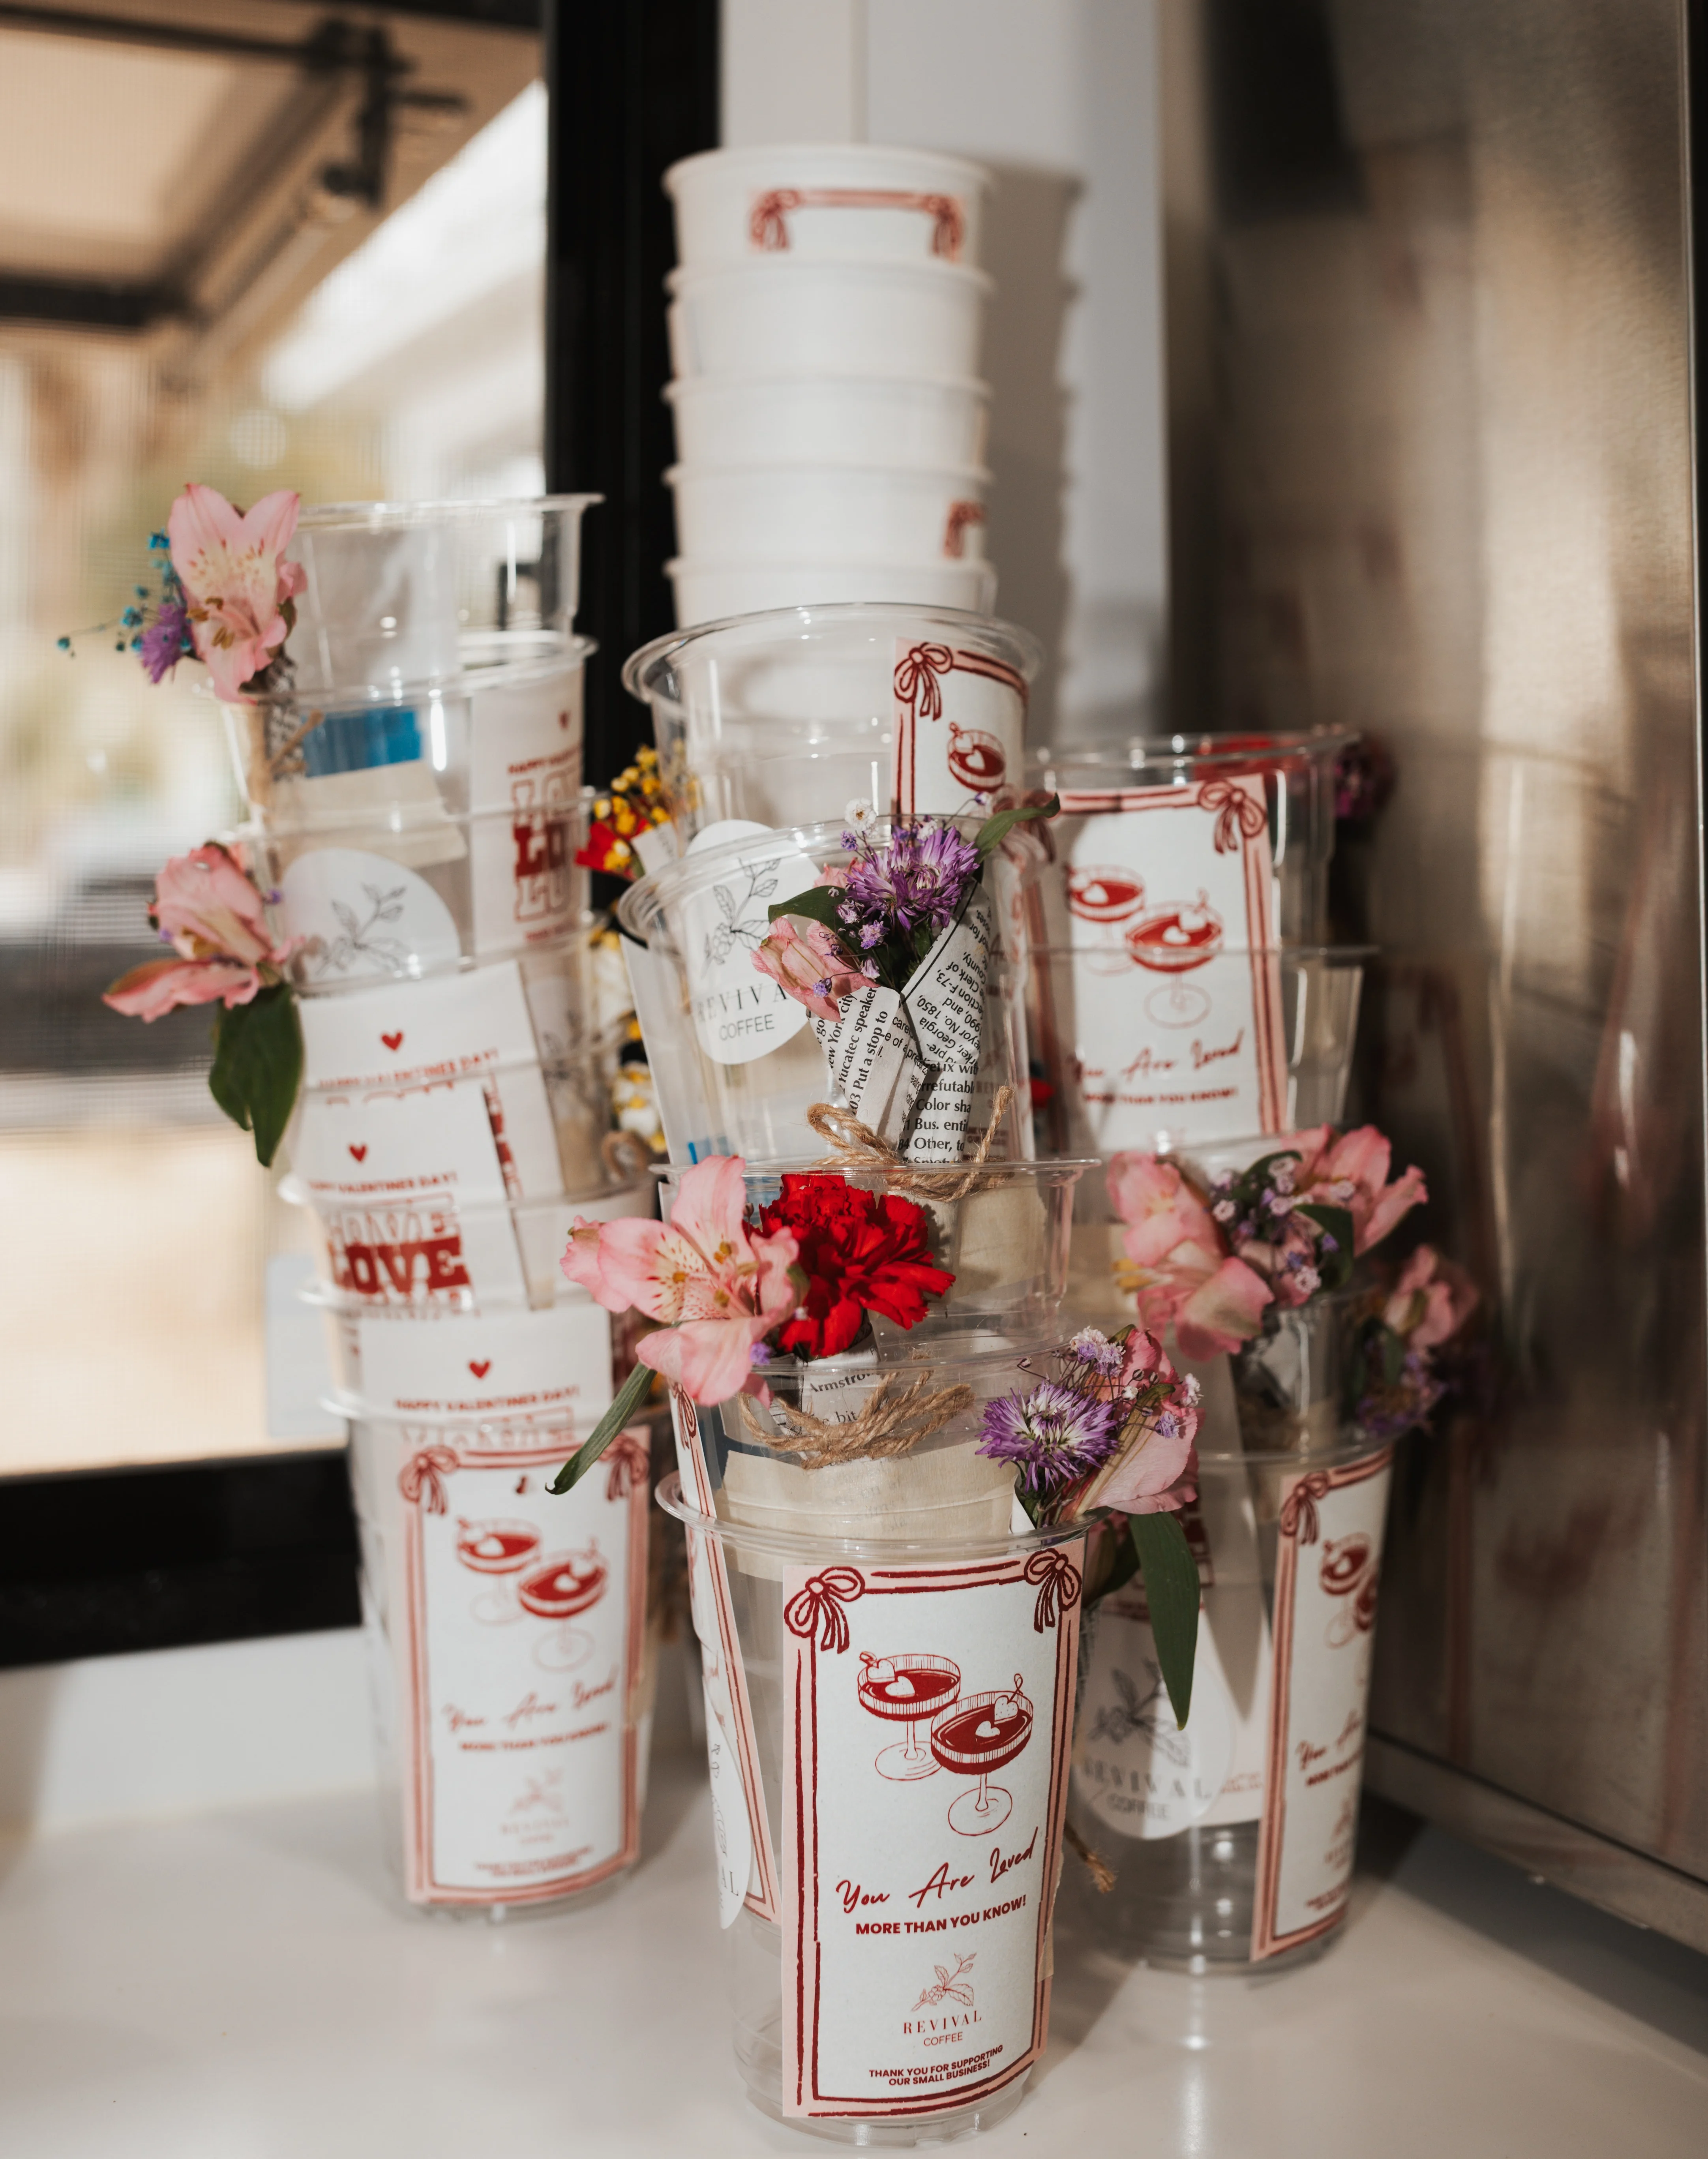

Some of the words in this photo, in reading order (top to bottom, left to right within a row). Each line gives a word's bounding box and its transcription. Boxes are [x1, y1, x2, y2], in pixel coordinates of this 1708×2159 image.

[969, 923, 981, 939] for
[945, 961, 959, 972] of
[936, 969, 958, 994] F-73,
[958, 969, 979, 992] Clerk
[697, 983, 791, 1023] REVIVA
[838, 994, 857, 1013] city
[917, 995, 942, 1019] 1850,
[942, 997, 963, 1015] and
[719, 1013, 775, 1041] COFFEE
[875, 1011, 888, 1024] to
[945, 1015, 960, 1033] No.
[838, 1035, 860, 1084] Yucatec
[854, 987, 877, 1033] speaker
[867, 1026, 885, 1056] stop
[892, 1038, 904, 1048] of
[919, 1017, 956, 1049] Georgia
[864, 1058, 873, 1067] a
[853, 1067, 870, 1090] Put
[916, 1098, 951, 1111] Color
[915, 1118, 939, 1130] Bus.
[914, 1136, 952, 1152] Other,
[810, 1373, 871, 1392] Armstro
[834, 1411, 858, 1423] bit
[836, 1880, 890, 1913] You
[908, 1862, 975, 1908] Are
[989, 1826, 1039, 1883] Loved
[856, 1923, 901, 1934] MORE
[904, 1919, 947, 1933] THAN
[950, 1911, 980, 1928] YOU
[983, 1894, 1026, 1920] KNOW!
[904, 2010, 982, 2034] REVIVAL
[924, 2031, 963, 2046] COFFEE
[869, 2068, 904, 2078] THANK
[907, 2066, 928, 2076] YOU
[930, 2064, 949, 2074] FOR
[951, 2045, 1003, 2070] SUPPORTING
[889, 2078, 910, 2086] OUR
[913, 2074, 944, 2085] SMALL
[947, 2059, 990, 2080] BUSINESS!
